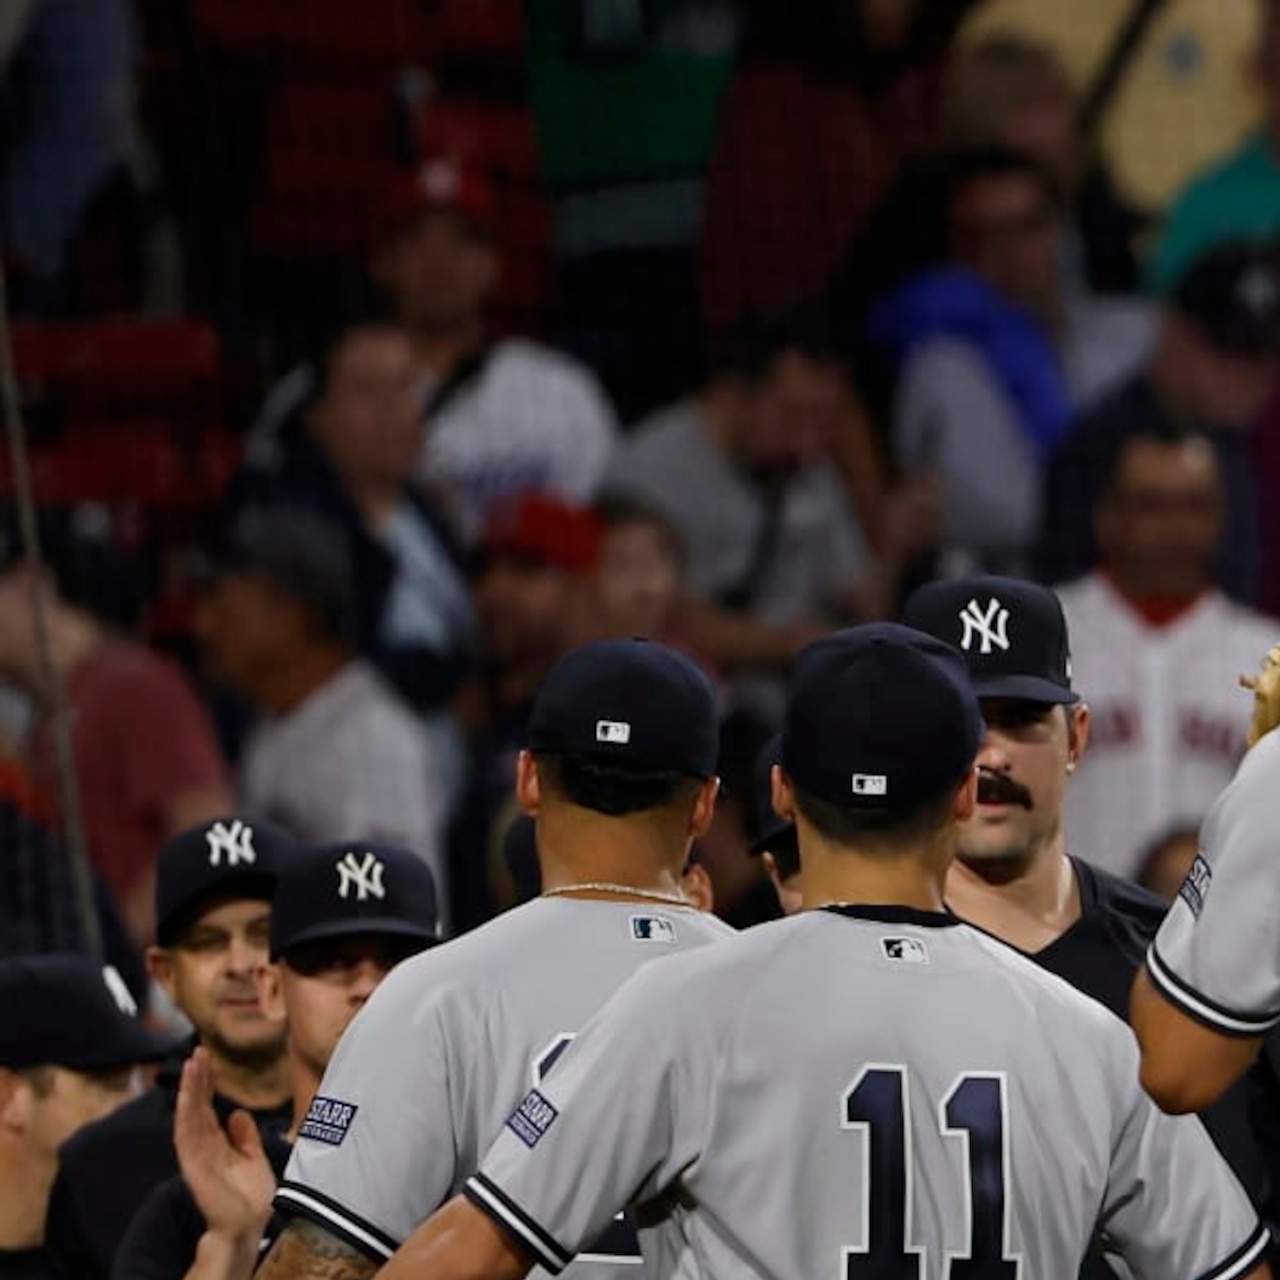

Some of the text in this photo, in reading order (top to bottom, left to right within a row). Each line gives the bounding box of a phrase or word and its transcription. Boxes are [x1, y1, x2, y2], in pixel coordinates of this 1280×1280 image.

[959, 598, 1010, 653] NY
[206, 819, 255, 866] NY
[336, 852, 386, 899] NY
